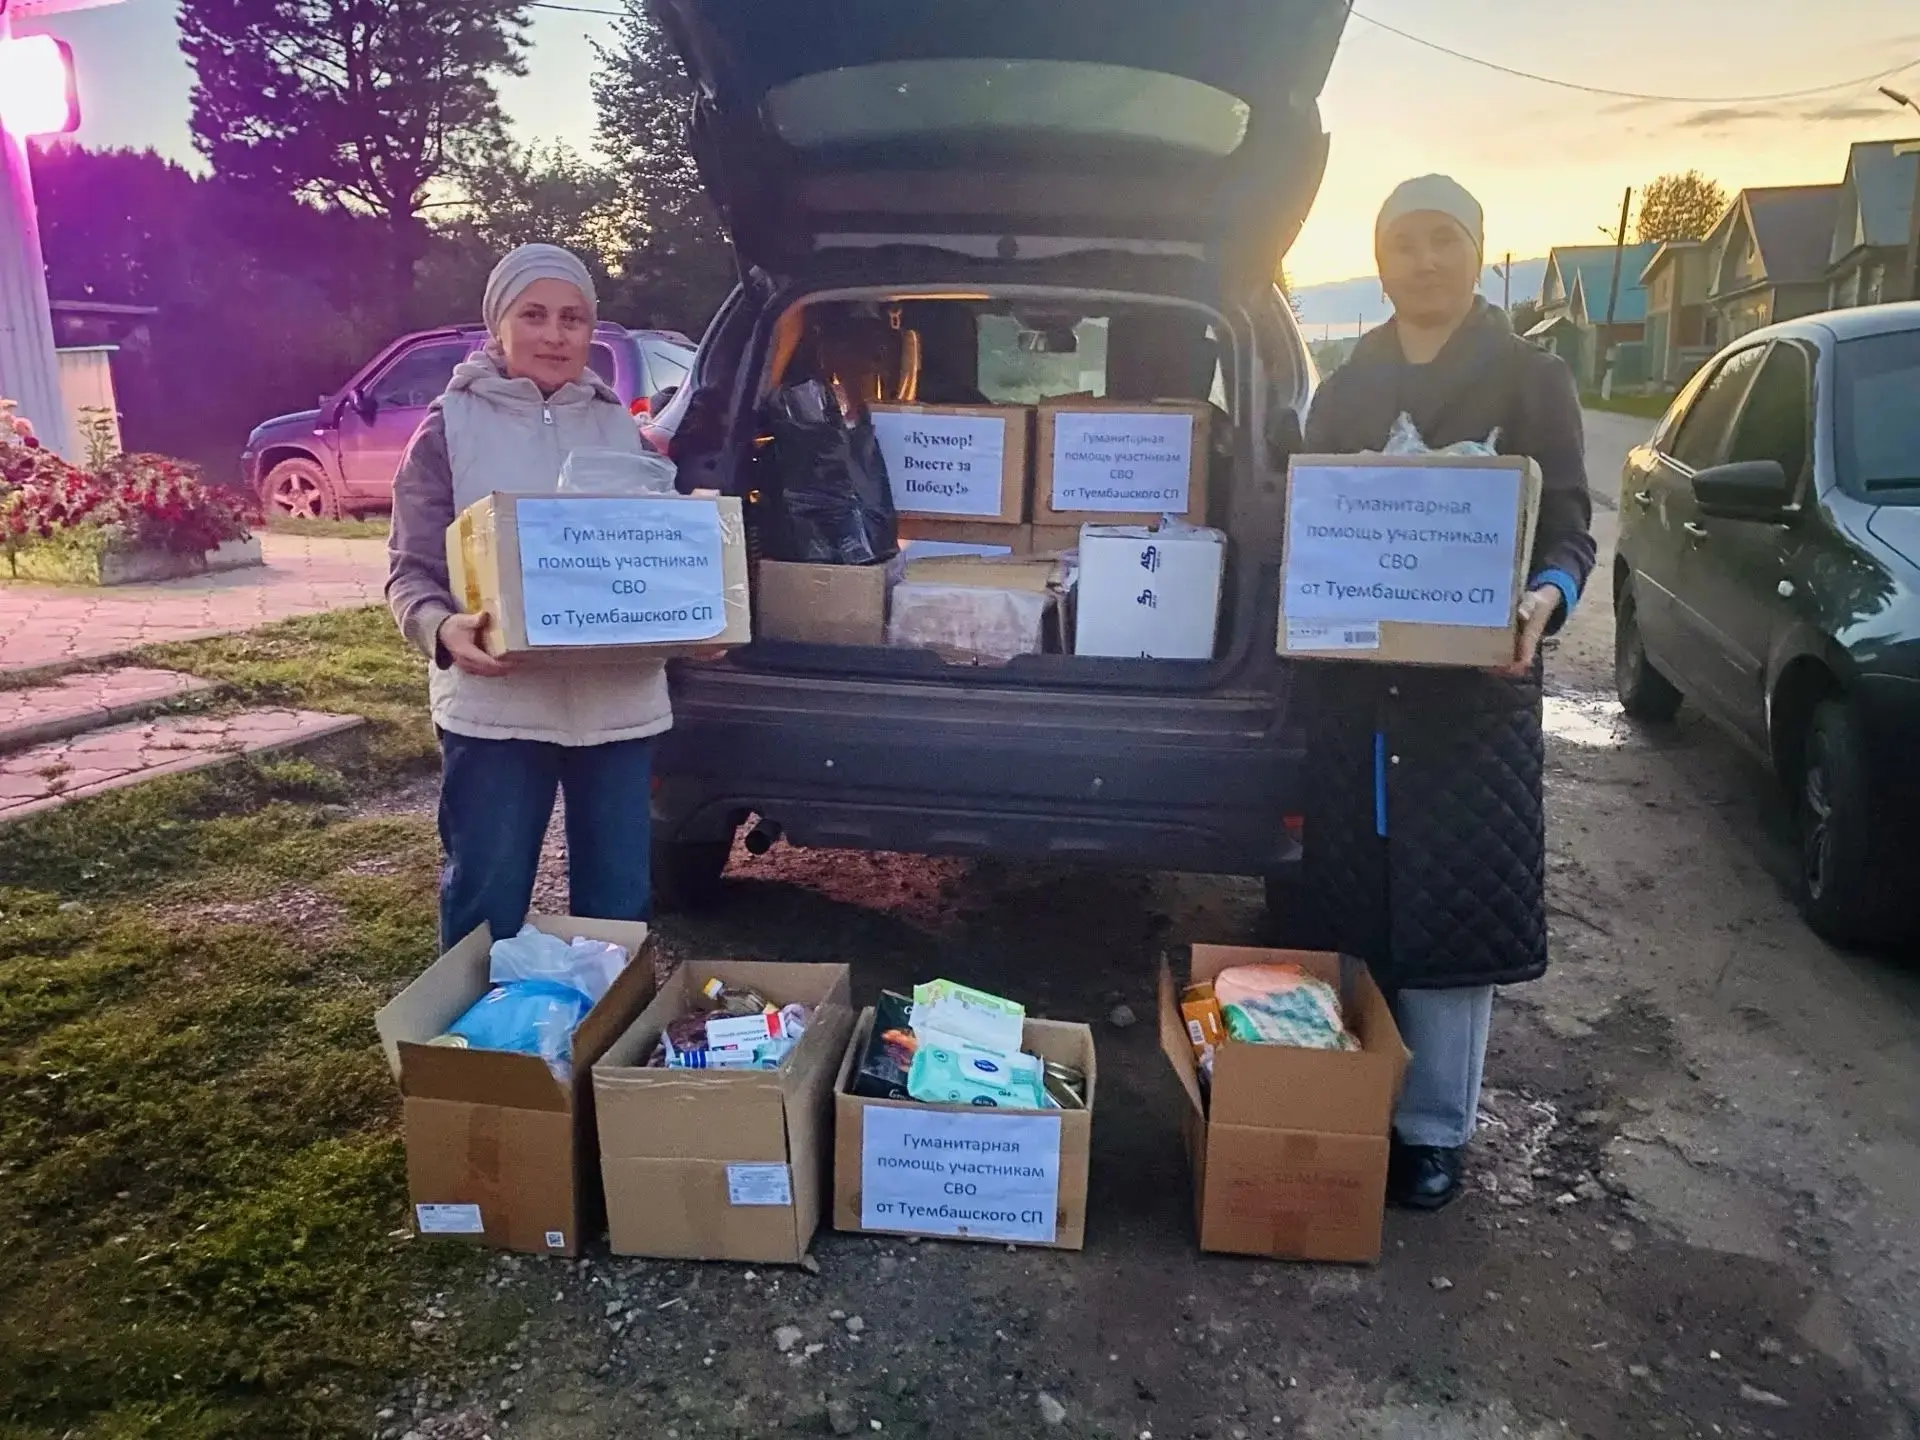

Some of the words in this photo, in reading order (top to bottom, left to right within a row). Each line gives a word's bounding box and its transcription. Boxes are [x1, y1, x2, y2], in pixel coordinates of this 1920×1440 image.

[904, 431, 973, 449] «Кукмор!
[1083, 432, 1164, 446] Гуманитарная
[904, 456, 953, 472] Вместе
[958, 462, 971, 473] за
[1065, 452, 1111, 463] помощь
[1114, 452, 1181, 464] участникам
[1110, 469, 1134, 480] СВО
[906, 480, 969, 497] Победу!»
[1063, 489, 1076, 498] от
[1078, 488, 1160, 501] Туембашского
[1163, 489, 1179, 500] СП
[1336, 495, 1471, 515] Гуманитарная
[563, 527, 682, 544] Гуманитарная
[1306, 525, 1382, 541] помощь
[1388, 528, 1499, 544] участникам
[538, 556, 611, 569] помощь
[615, 555, 709, 570] участникам
[1379, 554, 1419, 570] СВО
[612, 580, 647, 594] СВО
[1301, 583, 1320, 595] от
[1325, 580, 1463, 604] Туембашского
[1468, 588, 1495, 604] СП
[541, 613, 561, 626] от
[565, 607, 687, 627] Туембашского
[692, 606, 712, 621] СП
[904, 1133, 1020, 1154] Гуманитарная
[877, 1156, 944, 1172] помощь
[950, 1162, 1045, 1178] участникам
[944, 1182, 977, 1196] СВО
[876, 1203, 893, 1214] от
[898, 1202, 1016, 1223] Туембашского
[1021, 1210, 1043, 1224] СП
